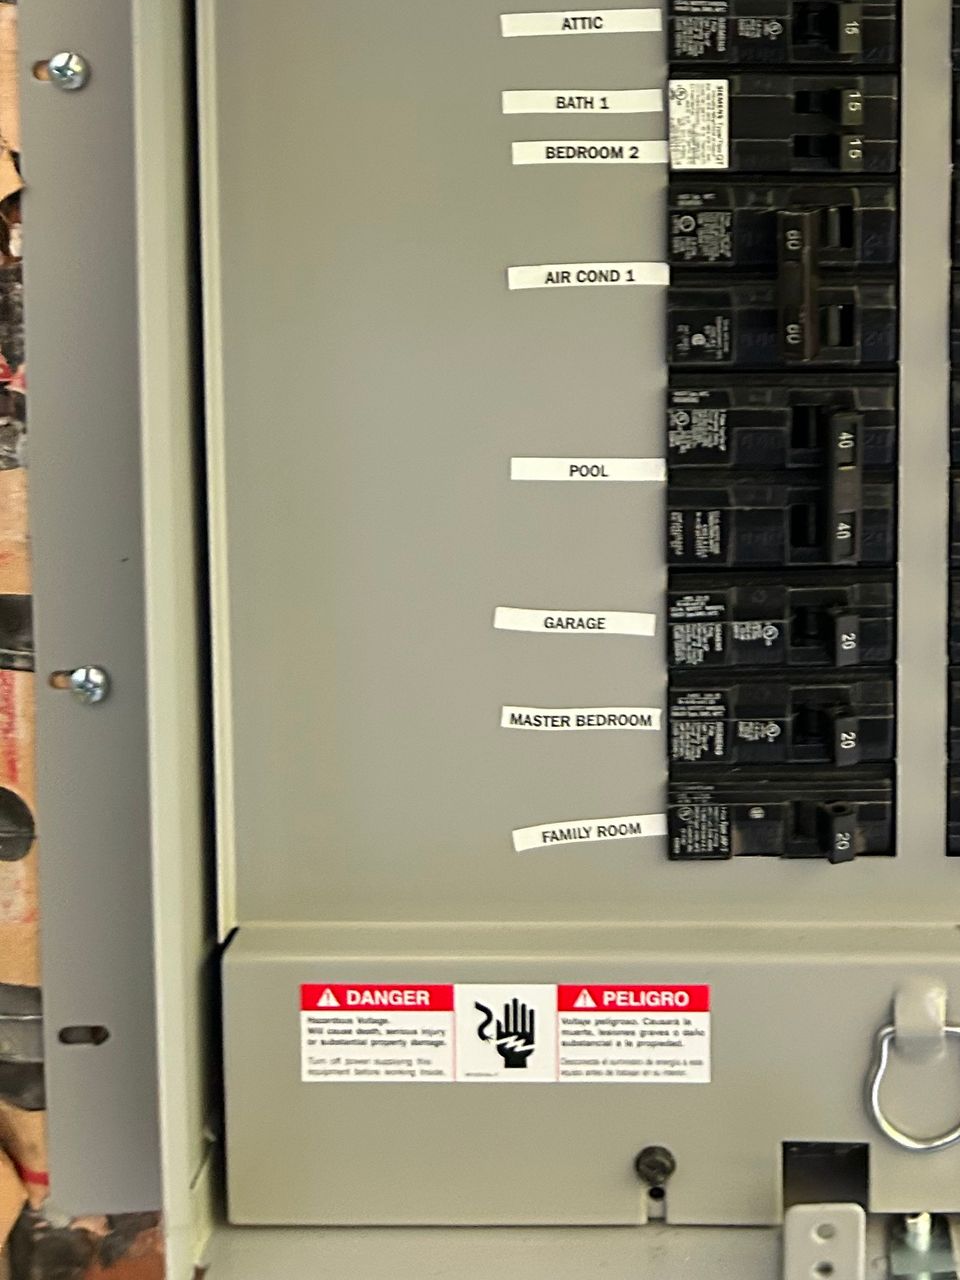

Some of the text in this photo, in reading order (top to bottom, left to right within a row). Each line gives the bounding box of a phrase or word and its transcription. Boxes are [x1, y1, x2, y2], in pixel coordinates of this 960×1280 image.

[561, 17, 603, 30] ATTIC
[556, 96, 609, 109] BATH 1
[546, 146, 639, 159] BEDROOM 2
[545, 269, 635, 284] AIR COND 1
[838, 431, 854, 448] 40
[569, 465, 609, 477] POOL
[835, 521, 851, 539] 40
[544, 617, 606, 629] GARAGE
[841, 633, 856, 650] 20
[511, 713, 652, 727] MASTER BEDROOM
[840, 731, 855, 749] 20
[542, 822, 641, 843] FAMILY ROOM
[836, 831, 851, 851] 20
[346, 991, 430, 1006] DANGER
[603, 991, 689, 1007] PELIGRO
